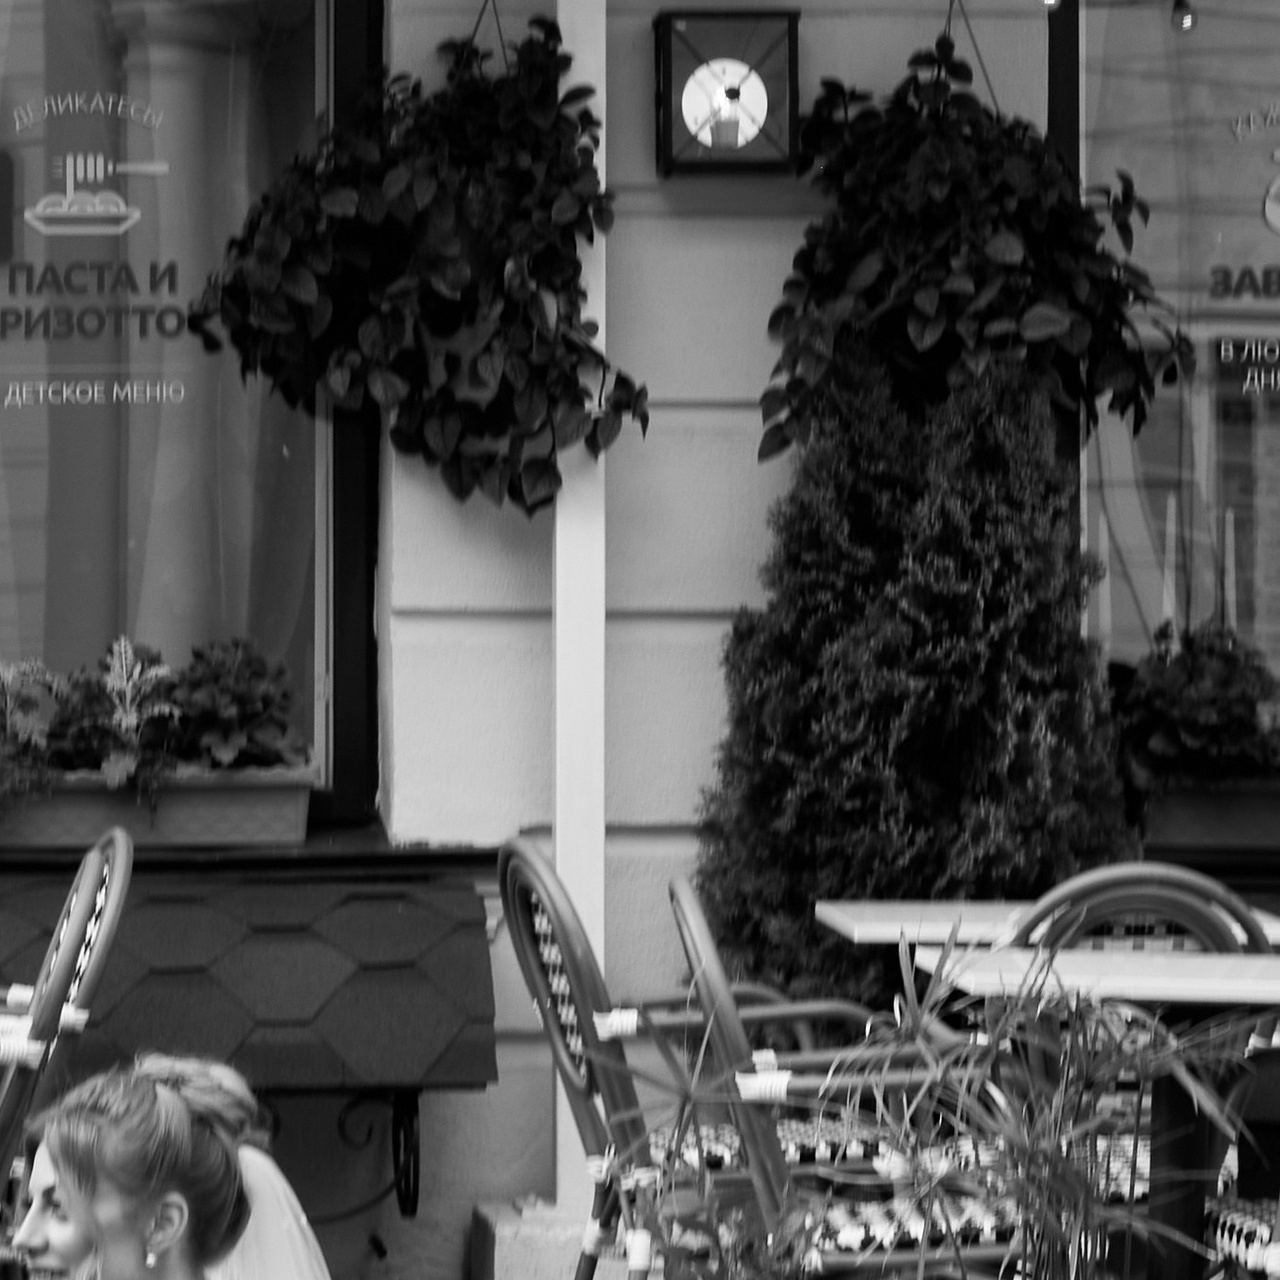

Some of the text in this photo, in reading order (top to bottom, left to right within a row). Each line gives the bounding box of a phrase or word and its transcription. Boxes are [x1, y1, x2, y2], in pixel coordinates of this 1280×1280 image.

[13, 91, 165, 135] ДЕЛИКАТЕСЫ
[7, 261, 179, 296] ПАСТА И
[0, 305, 187, 341] РИЗОТТО
[1220, 338, 1234, 364] В
[4, 380, 186, 409] ДЕТСКОЕ МЕНЮ
[1242, 366, 1280, 396] ДН
